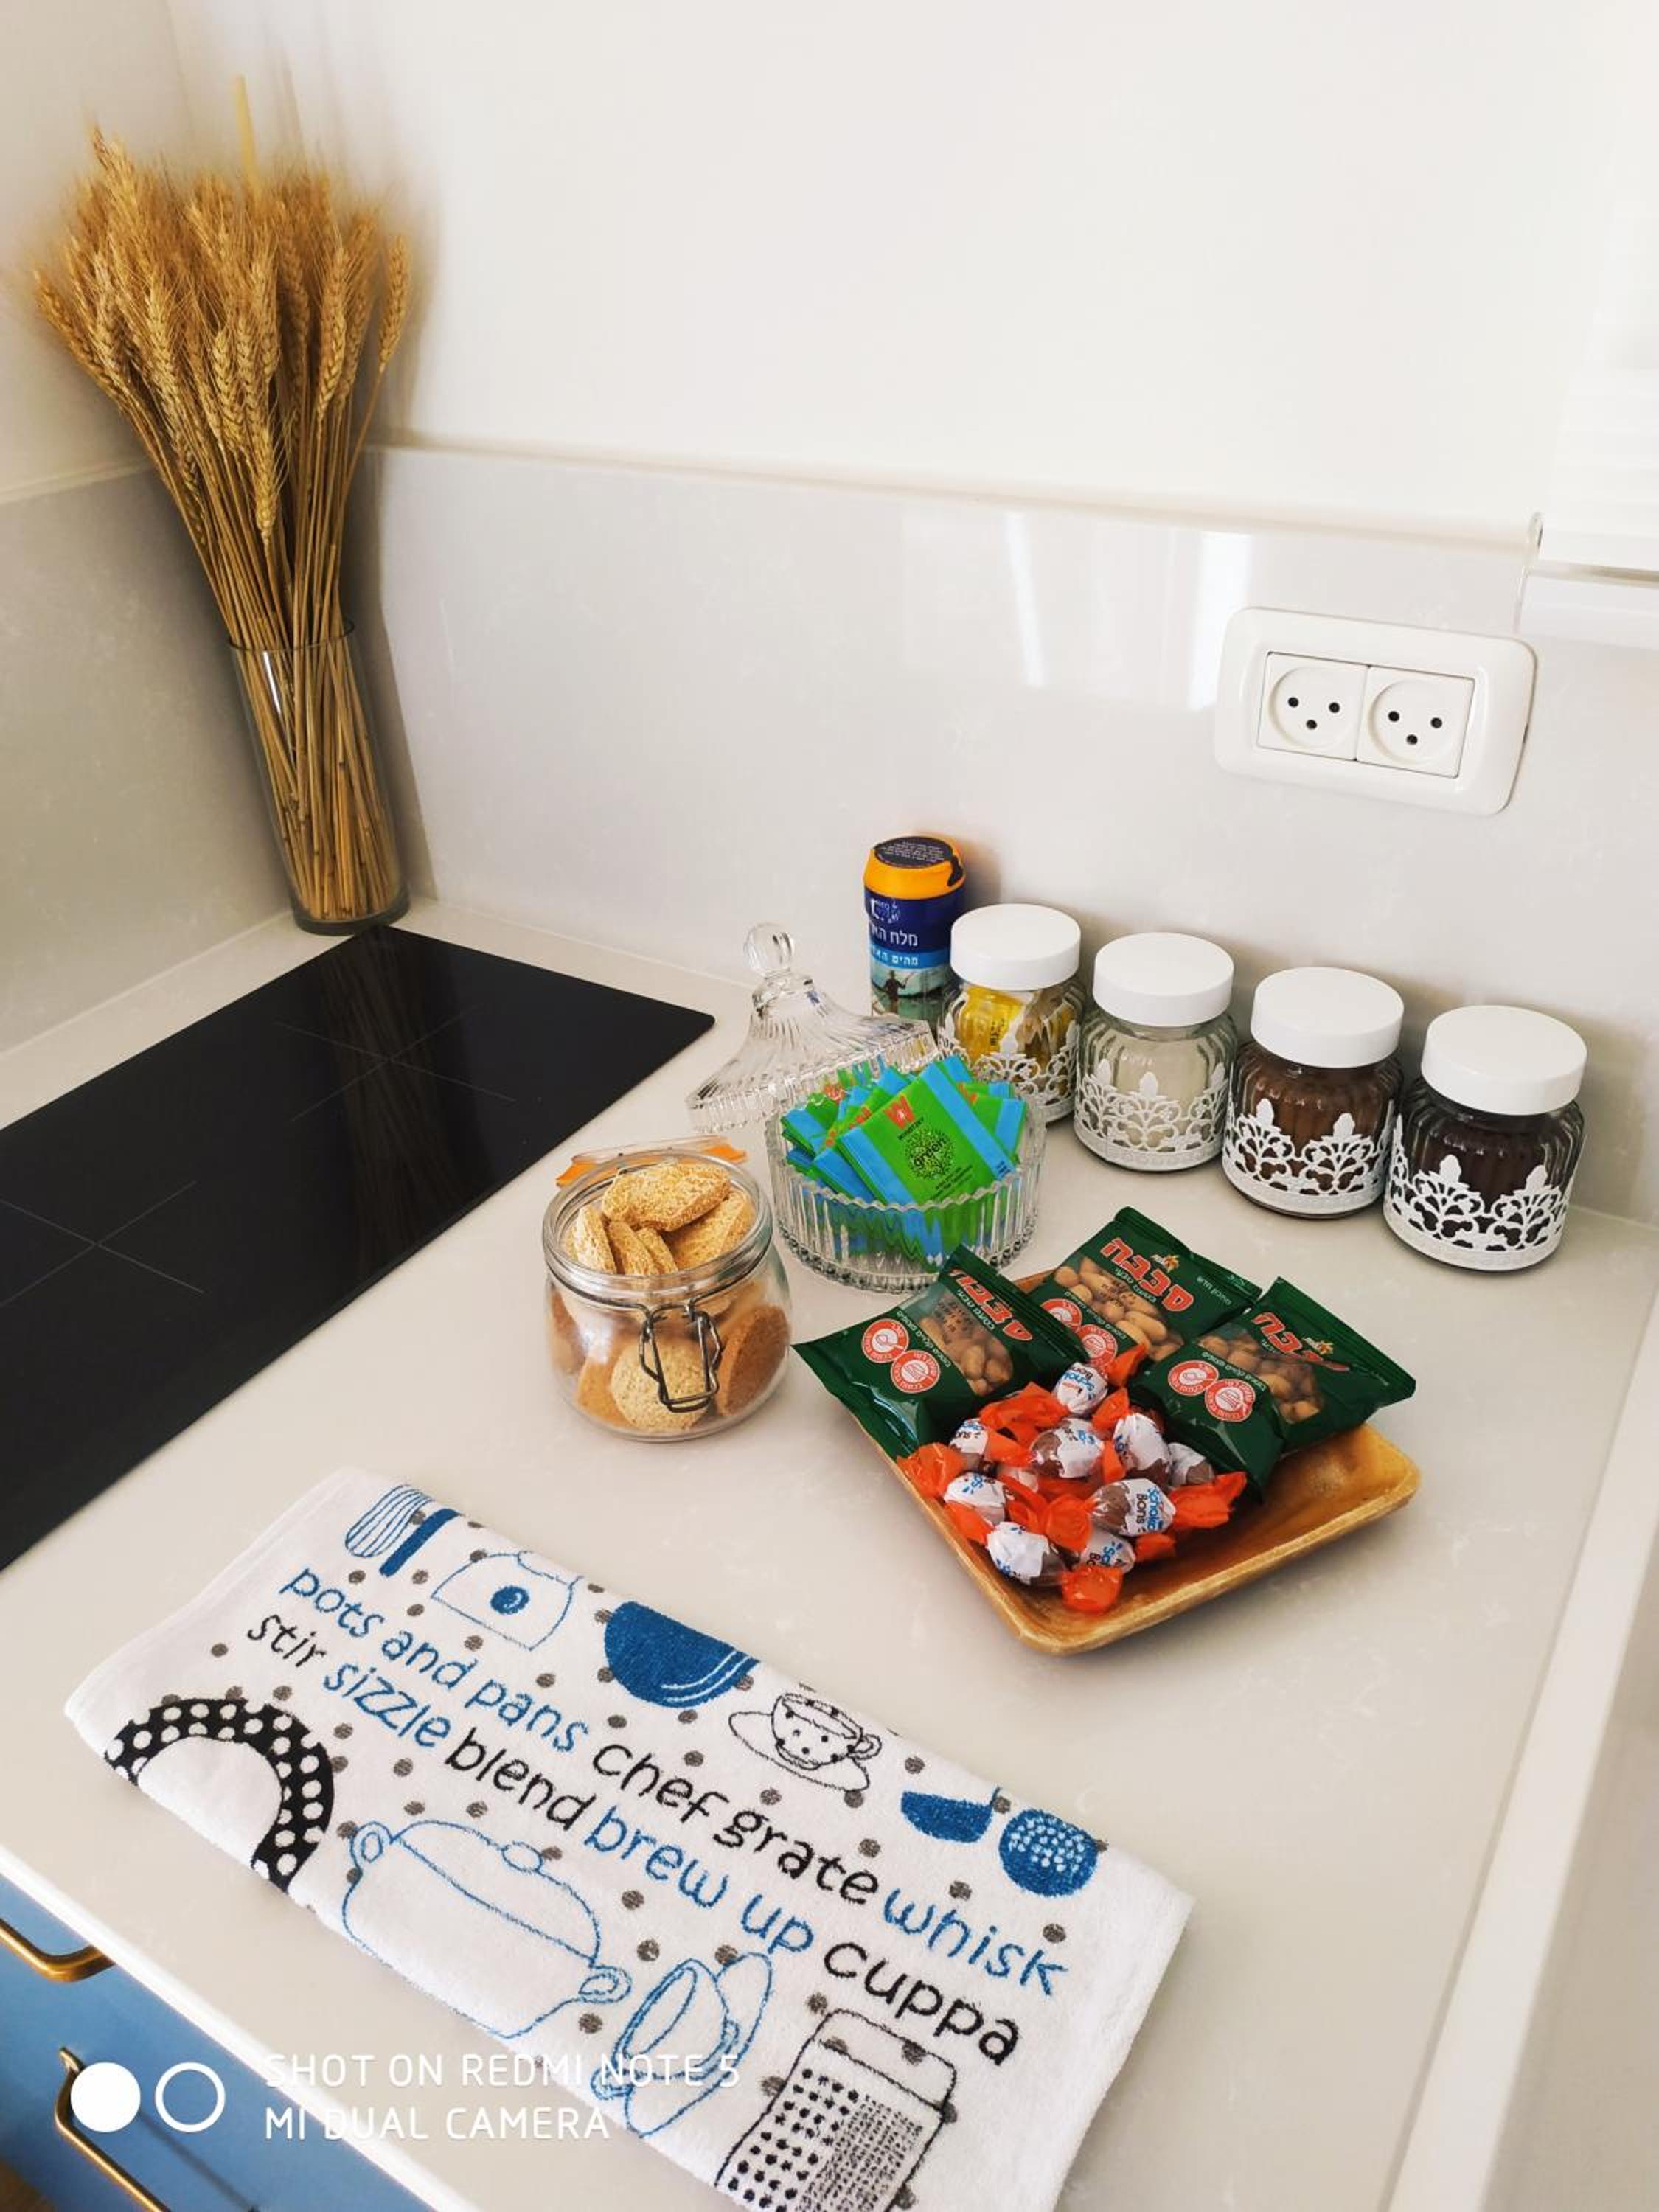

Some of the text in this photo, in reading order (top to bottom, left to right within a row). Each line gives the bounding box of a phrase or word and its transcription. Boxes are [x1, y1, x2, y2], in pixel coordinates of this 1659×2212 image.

[891, 930, 918, 947] מלח
[913, 1138, 947, 1170] green
[1135, 1493, 1148, 1524] Bons
[278, 1568, 1071, 1996] pots and pans chef grate whisk
[247, 1613, 1020, 2066] stir sizzle blend brew up cuppa
